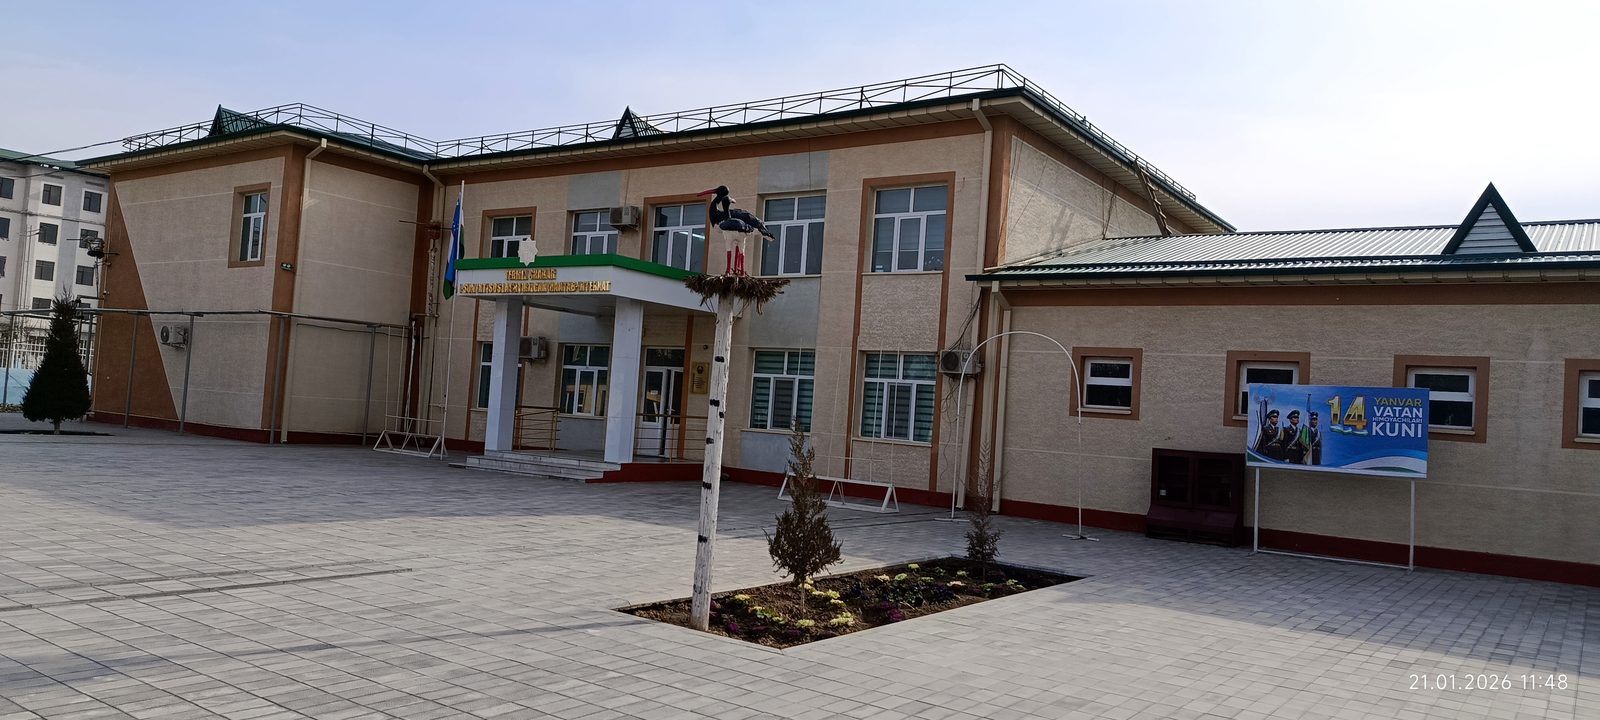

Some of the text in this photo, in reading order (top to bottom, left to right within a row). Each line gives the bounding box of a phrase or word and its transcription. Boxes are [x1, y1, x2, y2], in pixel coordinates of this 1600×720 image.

[1374, 397, 1422, 406] YANVAR
[1328, 395, 1367, 430] 14
[1373, 406, 1423, 418] VATAN
[1372, 416, 1423, 424] HIMOYACHILARI
[1372, 422, 1422, 438] KUNI
